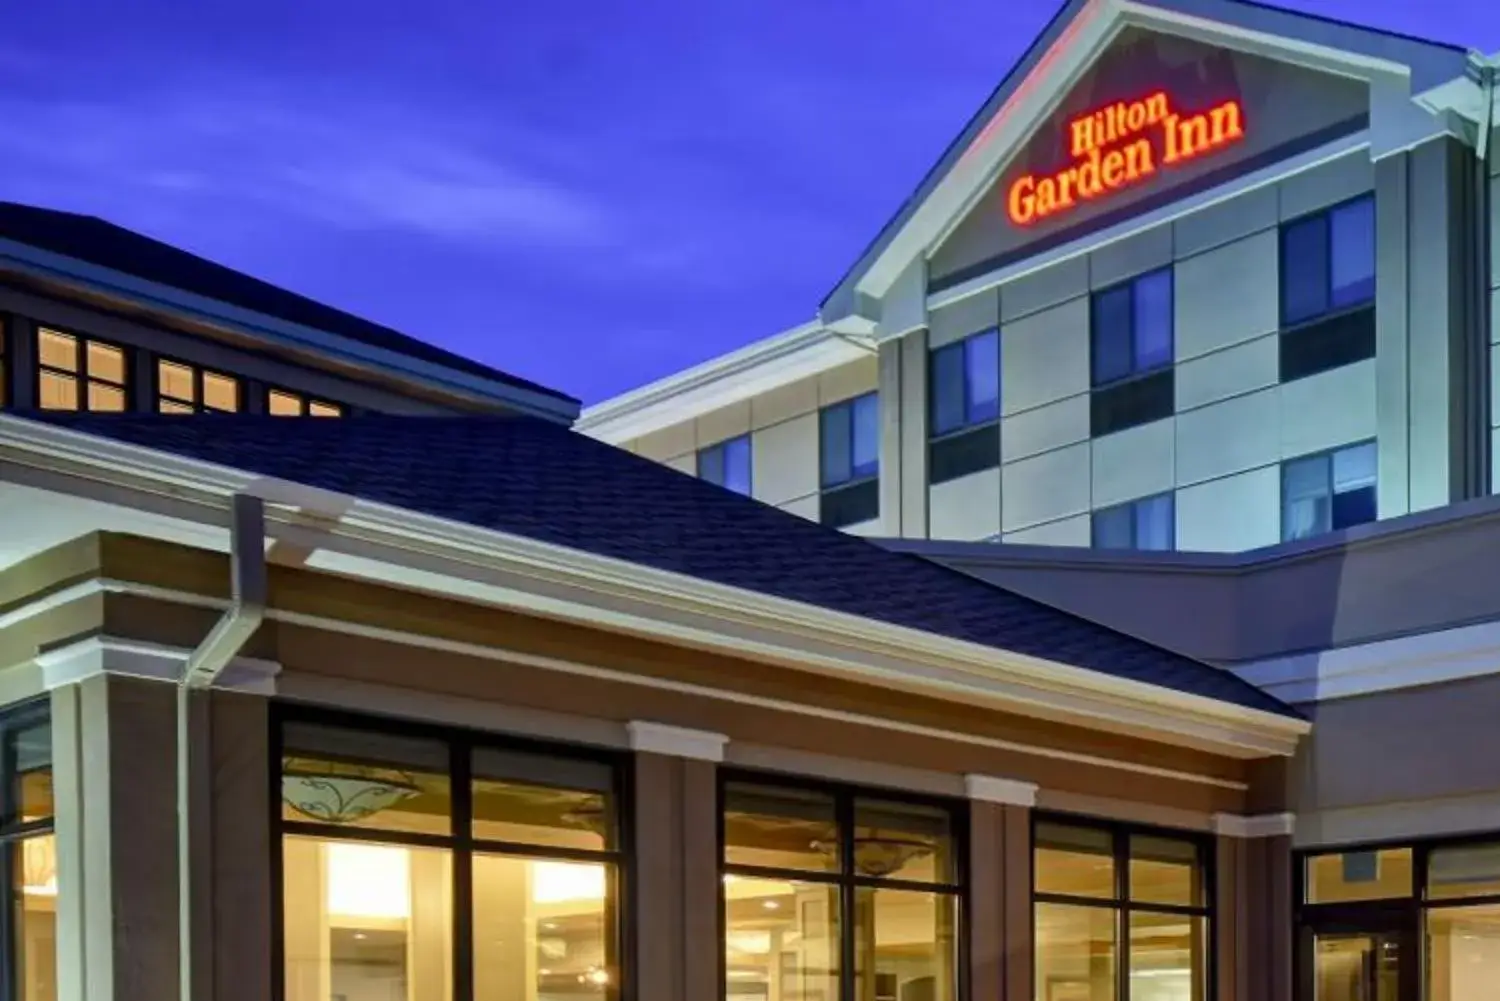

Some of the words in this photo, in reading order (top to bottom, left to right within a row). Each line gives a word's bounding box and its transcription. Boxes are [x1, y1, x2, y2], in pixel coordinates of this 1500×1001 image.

[1008, 137, 1155, 225] Garden
[1162, 100, 1244, 164] Inn
[1071, 91, 1169, 156] Hilton
